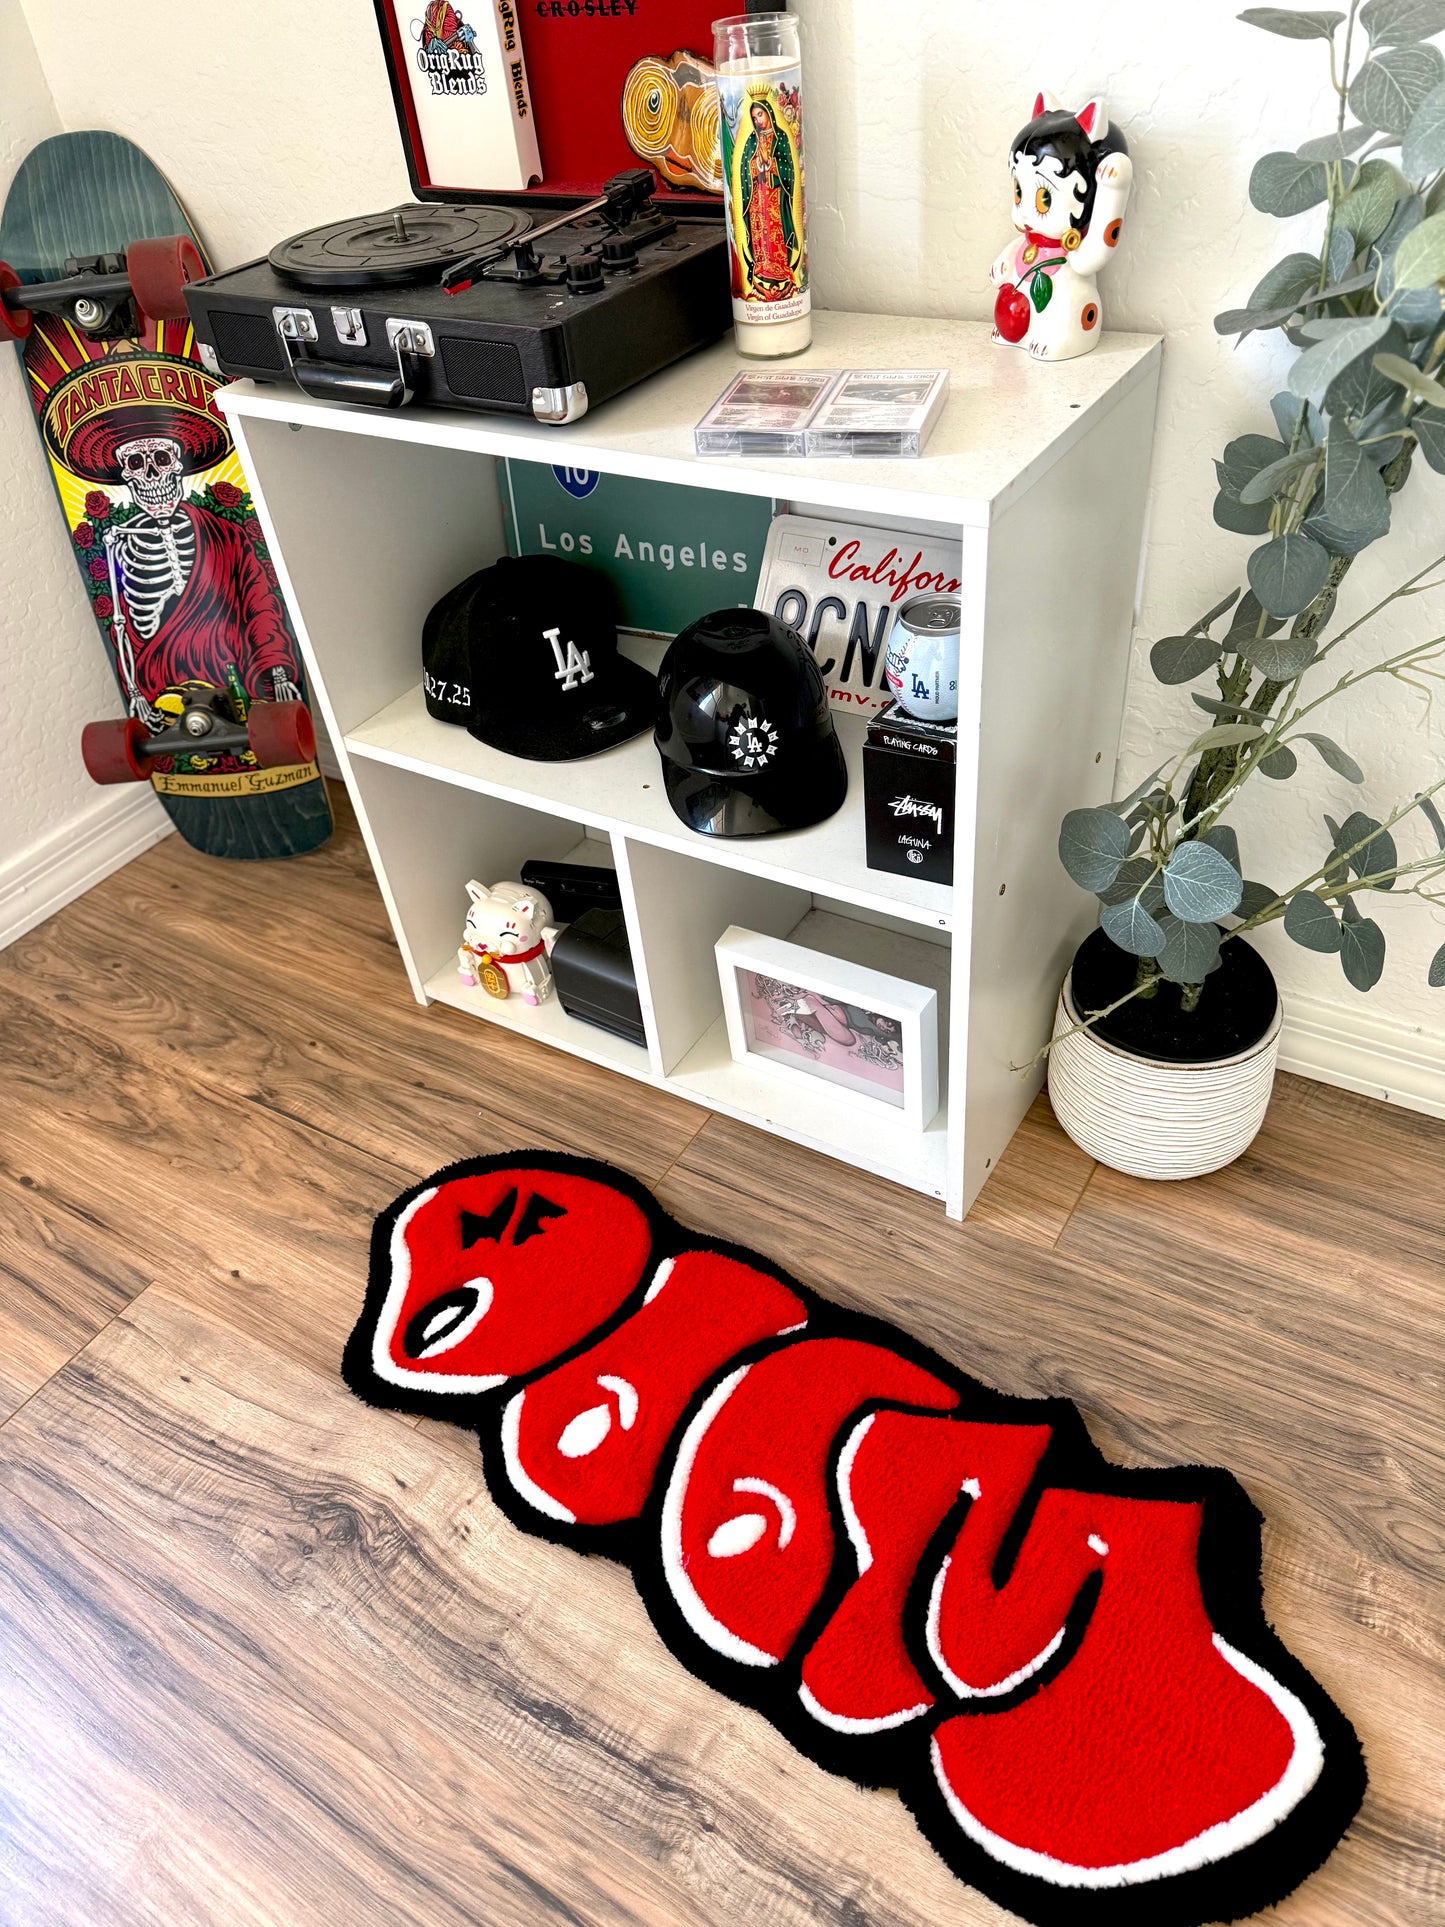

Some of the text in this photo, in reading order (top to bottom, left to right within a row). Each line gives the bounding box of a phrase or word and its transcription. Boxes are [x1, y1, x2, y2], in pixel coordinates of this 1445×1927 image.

[535, 0, 638, 18] CROSLEY
[417, 48, 485, 75] OrigRug
[428, 71, 487, 95] Blends
[510, 59, 527, 118] Blends
[745, 304, 764, 313] Virgen
[774, 299, 803, 311] Guadalupe
[747, 309, 802, 321] Virgin of Guadalupe
[539, 523, 748, 573] Los Angeles
[542, 627, 594, 691] LA
[911, 673, 930, 699] LA
[746, 732, 762, 753] LA
[883, 735, 938, 755] PLAYING CARDS
[159, 765, 312, 792] Emmanuel Guzman
[898, 835, 932, 850] LAGUNA
